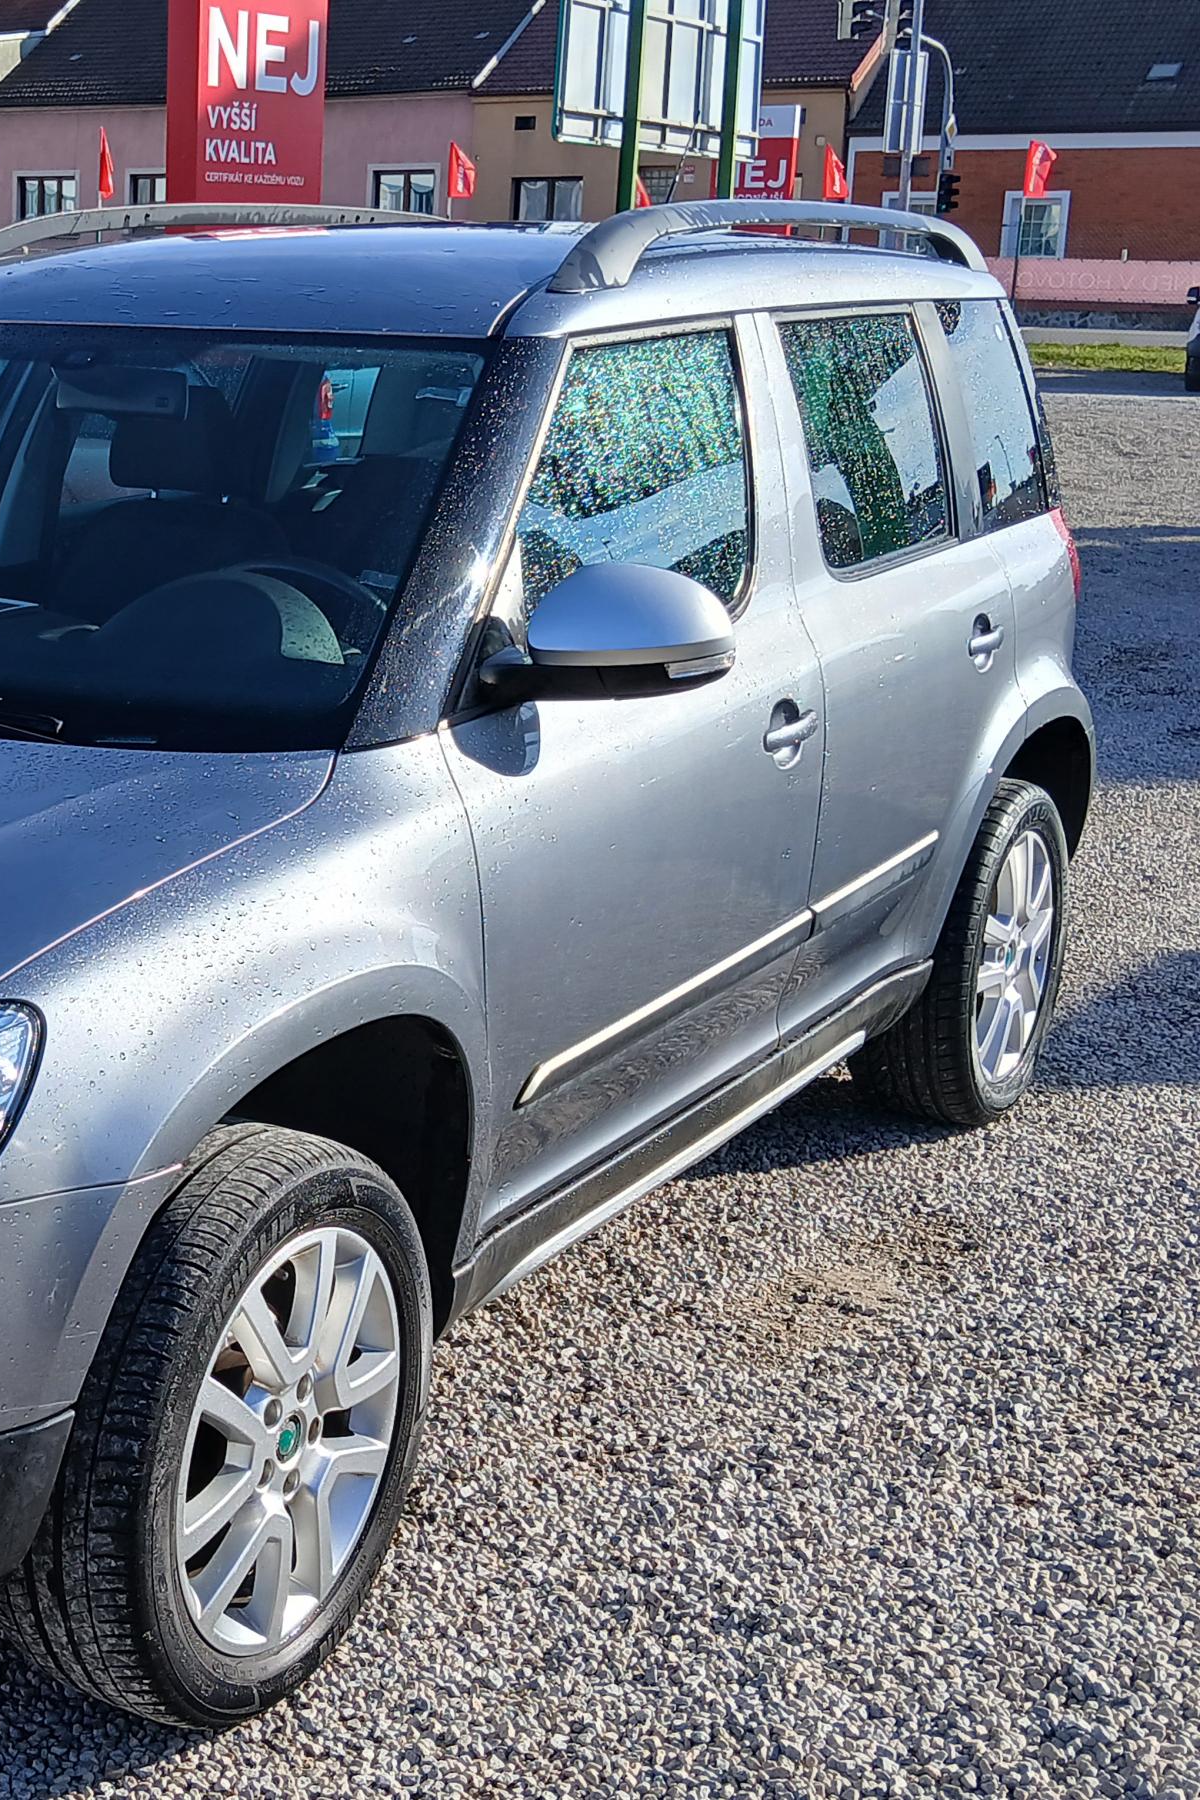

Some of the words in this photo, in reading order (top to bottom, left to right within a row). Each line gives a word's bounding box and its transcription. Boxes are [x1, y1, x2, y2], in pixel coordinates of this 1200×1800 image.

[207, 6, 319, 96] NEJ
[207, 101, 257, 131] VYŠŠÍ
[205, 138, 276, 165] KVALITA
